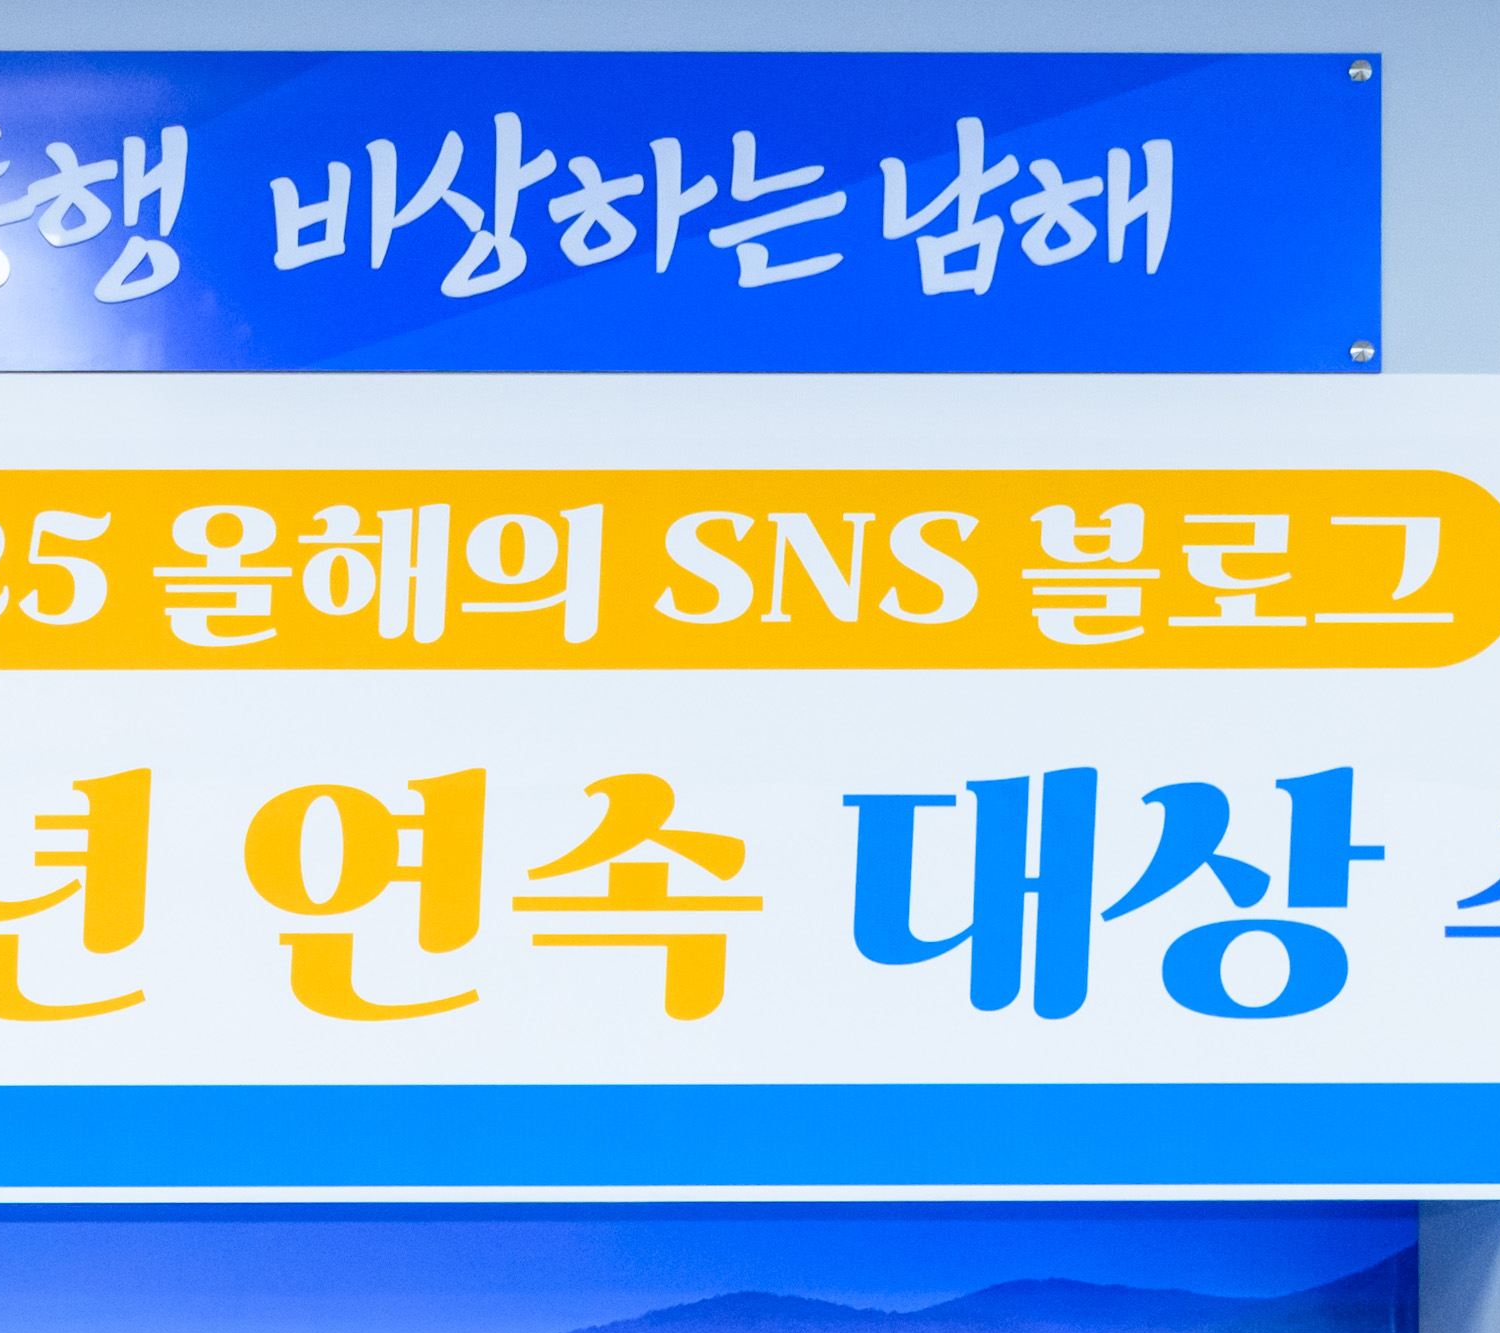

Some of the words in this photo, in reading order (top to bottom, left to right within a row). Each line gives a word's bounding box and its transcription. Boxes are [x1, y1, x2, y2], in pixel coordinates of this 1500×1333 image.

[270, 112, 847, 298] 비상하는
[879, 116, 1174, 297] 남해
[153, 501, 605, 646] 올해의
[653, 510, 981, 626] SNS
[1021, 502, 1454, 646] 블로그
[243, 767, 764, 1022] 연속
[842, 764, 1387, 1022] 대상
